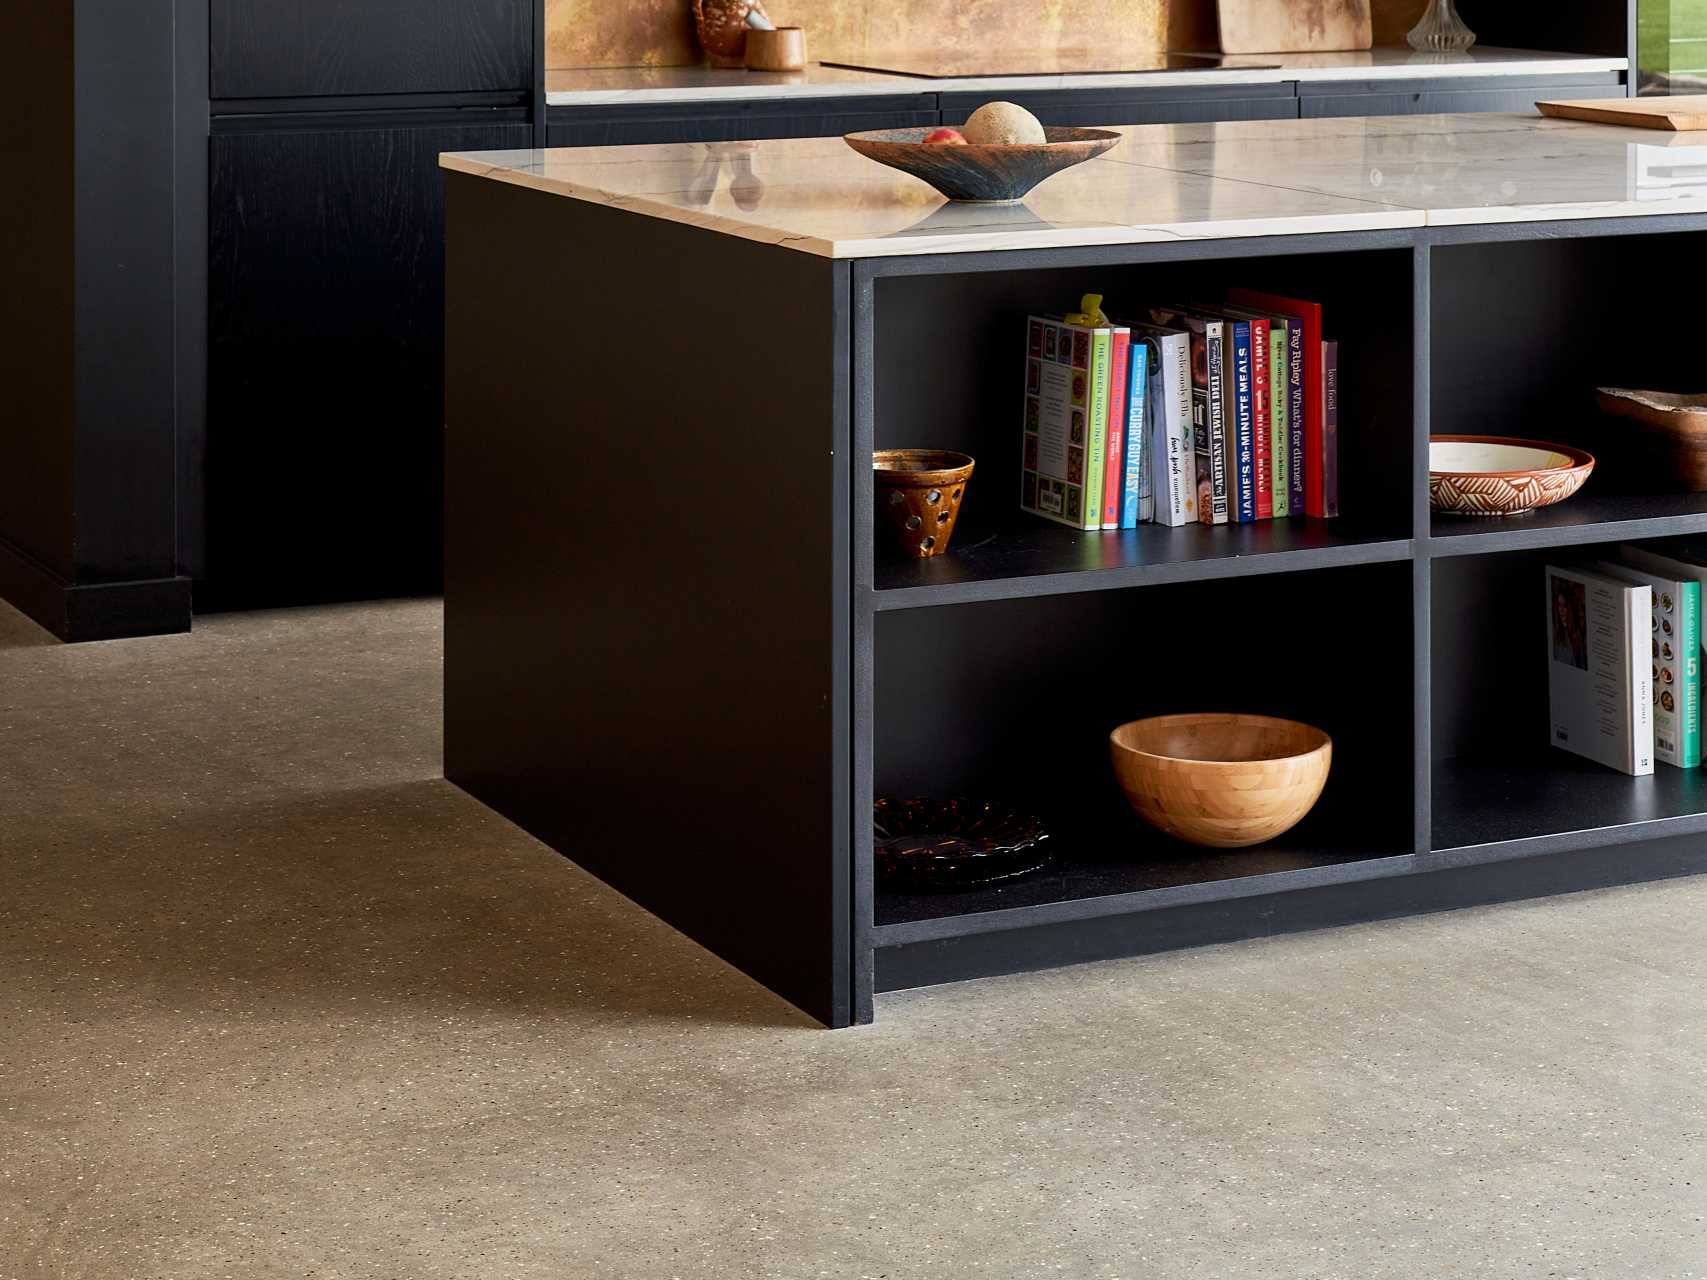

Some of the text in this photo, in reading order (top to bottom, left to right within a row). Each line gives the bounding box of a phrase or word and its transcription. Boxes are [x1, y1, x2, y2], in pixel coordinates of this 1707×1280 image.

[1238, 348, 1249, 392] MEALS
[1290, 328, 1301, 385] Fay Ripley
[1176, 345, 1189, 417] Deliciously Ella
[1210, 375, 1220, 399] DELI
[1327, 368, 1337, 410] love food
[1094, 396, 1103, 444] ROASTING
[1128, 408, 1143, 443] CURRY
[1211, 402, 1223, 439] JEWISH
[1240, 395, 1252, 463] 30-MINUTE
[1292, 388, 1302, 428] What's
[1128, 443, 1140, 465] GUY
[1293, 430, 1302, 447] for
[1126, 466, 1139, 494] EASY
[1213, 443, 1224, 486] ARTISAN
[1293, 448, 1302, 492] dinner?
[1241, 465, 1253, 517] JAMIE'S
[1687, 657, 1696, 734] 5 INGREDIENTS
